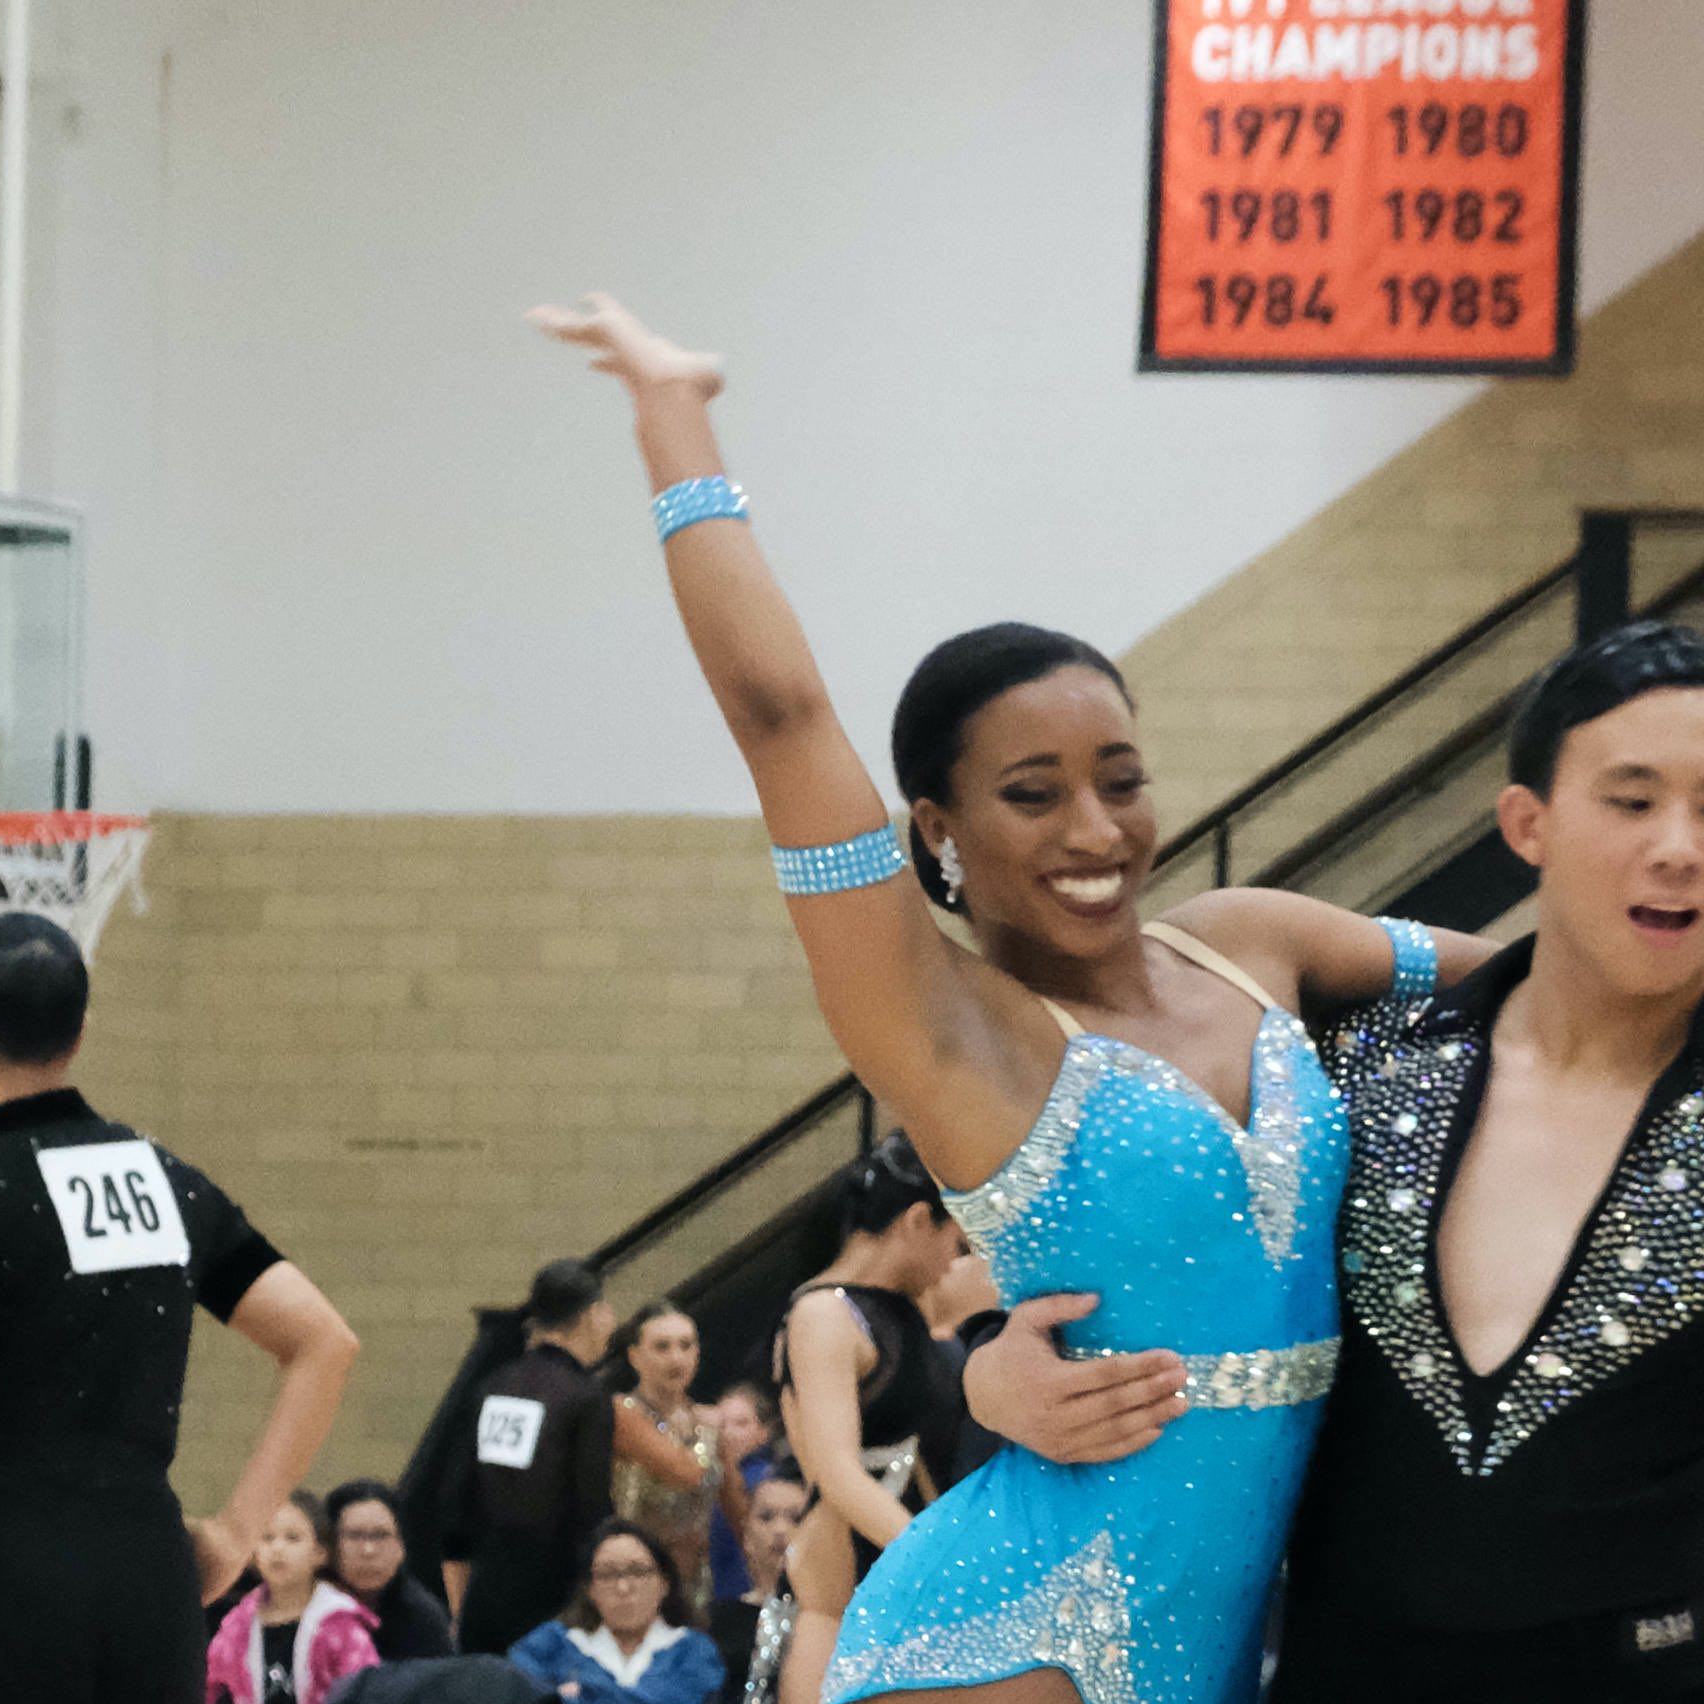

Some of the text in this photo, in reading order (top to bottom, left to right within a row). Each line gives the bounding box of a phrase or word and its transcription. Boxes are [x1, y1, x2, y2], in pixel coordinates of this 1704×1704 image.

[1191, 22, 1539, 82] CHAMPIONS
[1202, 103, 1529, 157] 1979 1980
[1200, 190, 1523, 243] 1981 1982
[1196, 273, 1522, 328] 1984 1985
[68, 1170, 160, 1238] 246
